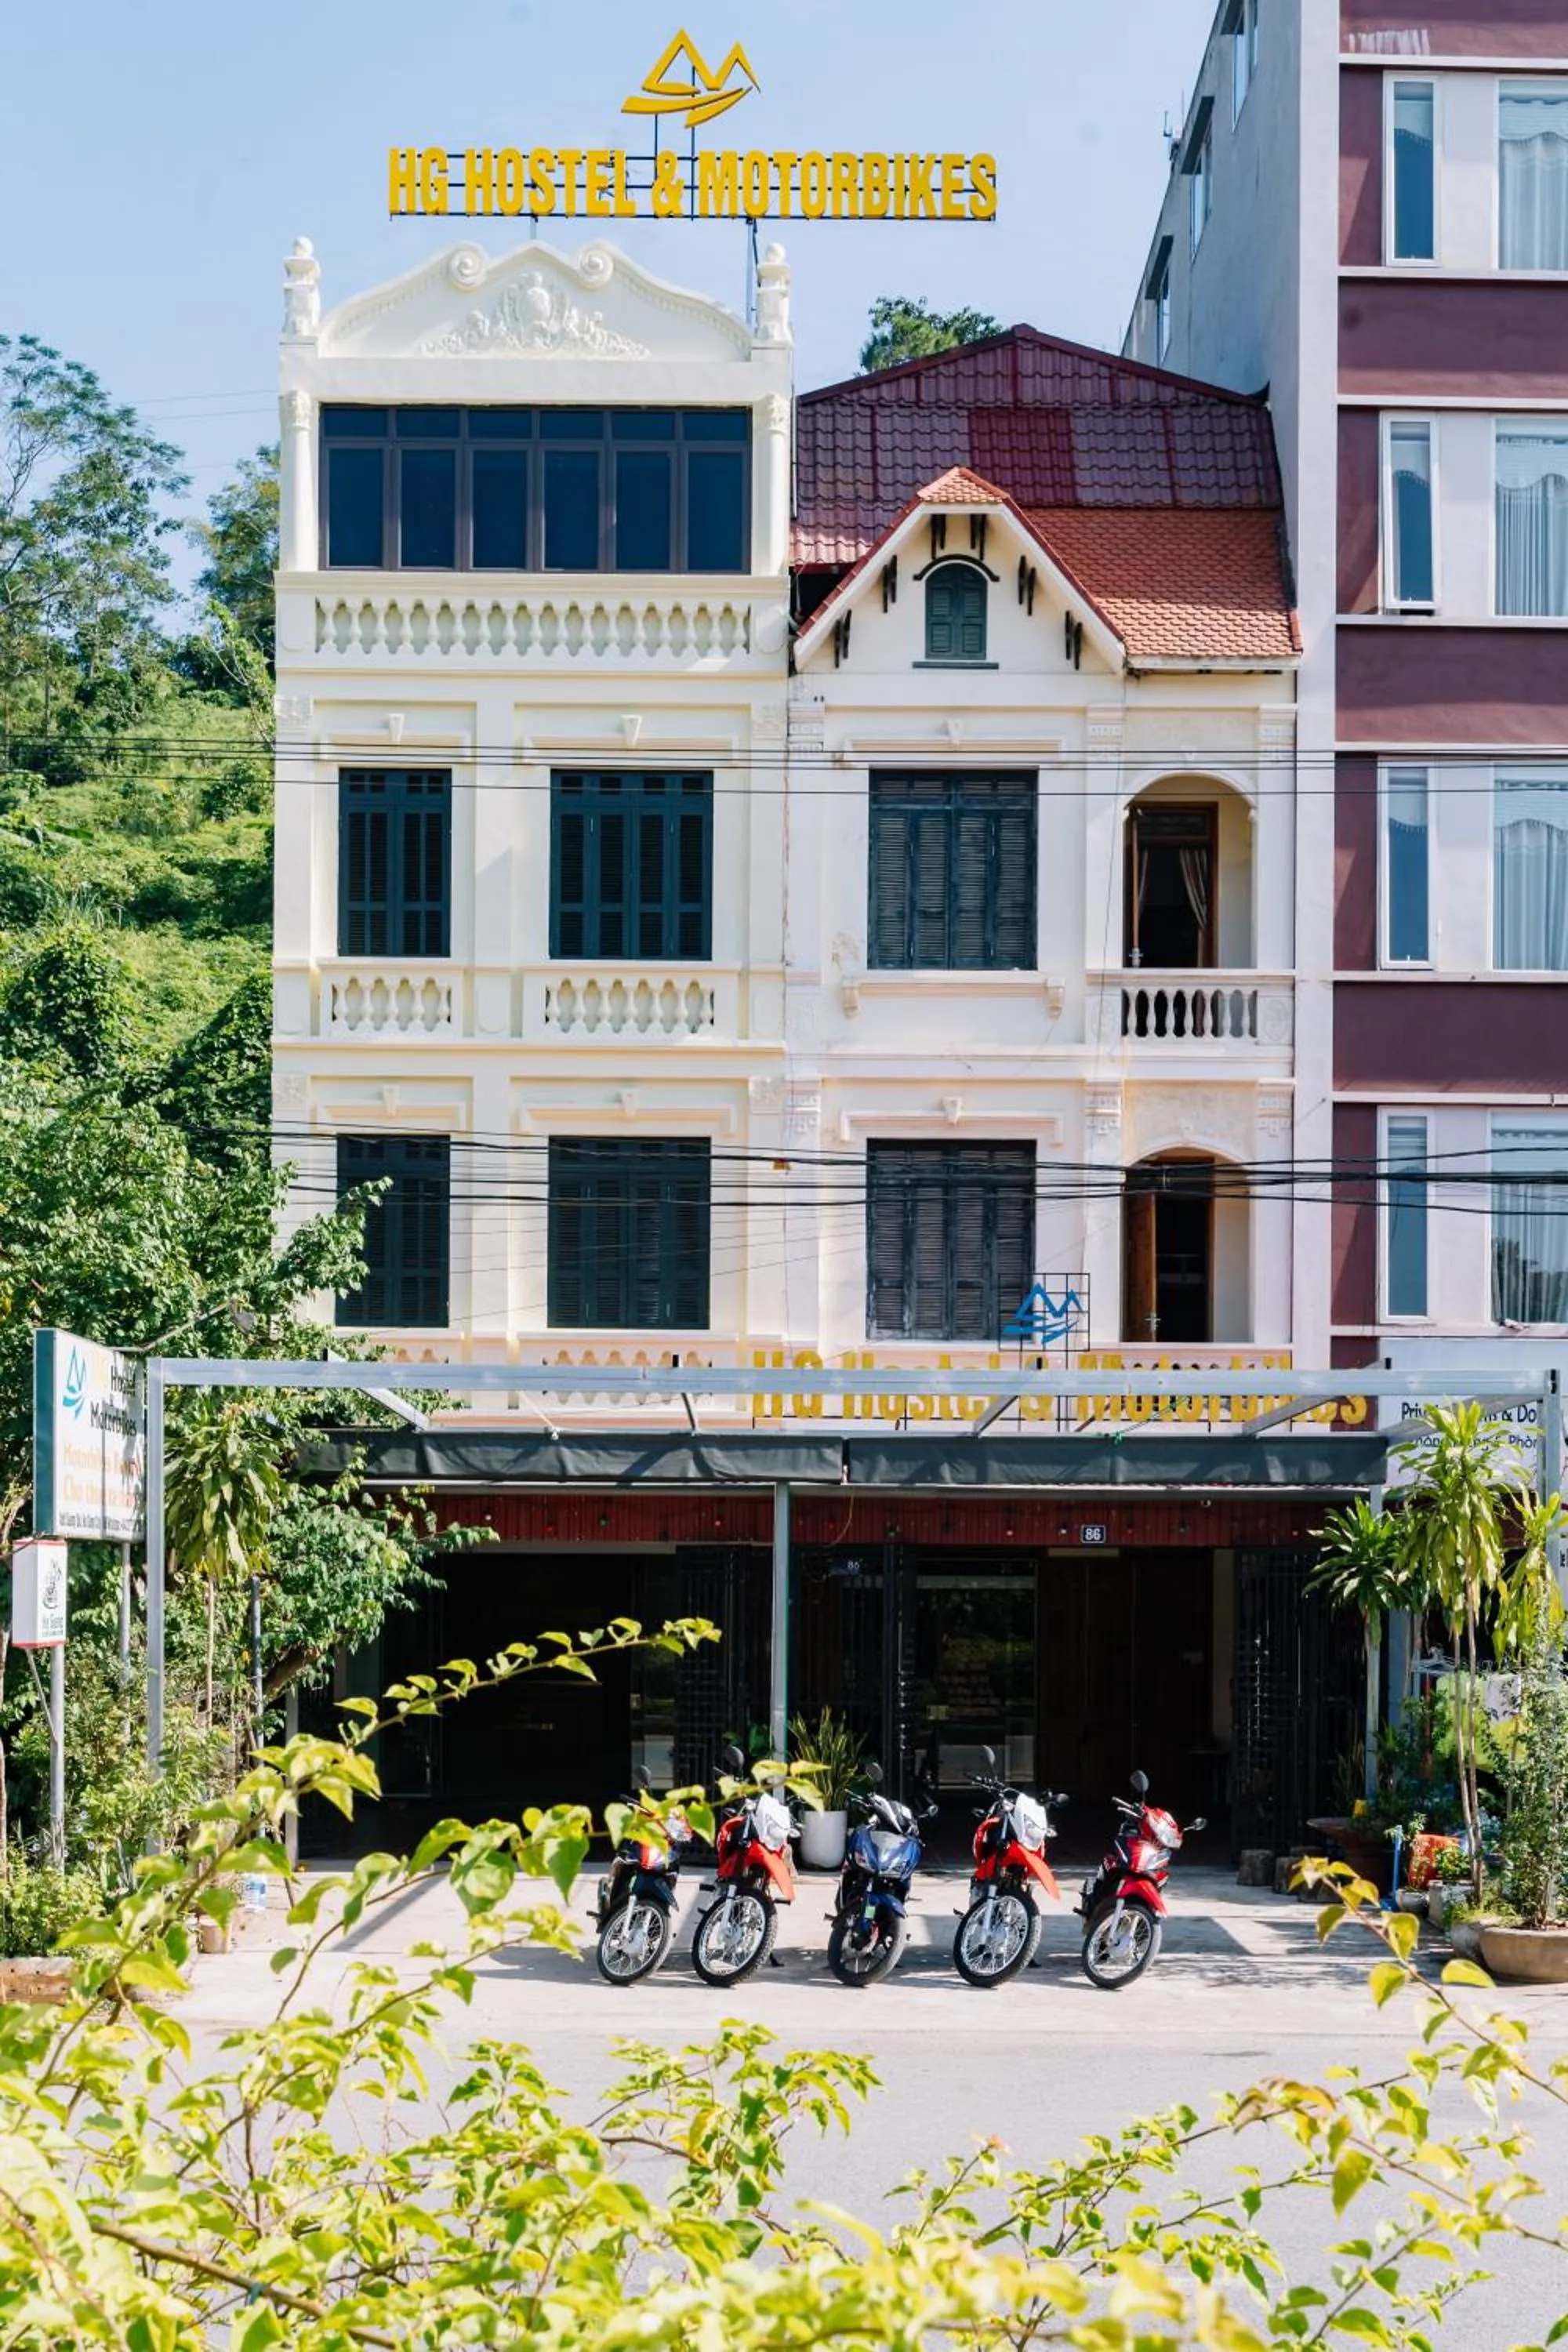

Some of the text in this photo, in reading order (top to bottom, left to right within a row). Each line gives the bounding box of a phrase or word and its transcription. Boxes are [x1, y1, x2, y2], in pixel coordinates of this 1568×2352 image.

[389, 147, 997, 221] HG HOSTEL & MOTORBIKES
[1077, 1353, 1368, 1425] Motobis
[1085, 1528, 1101, 1541] 86
